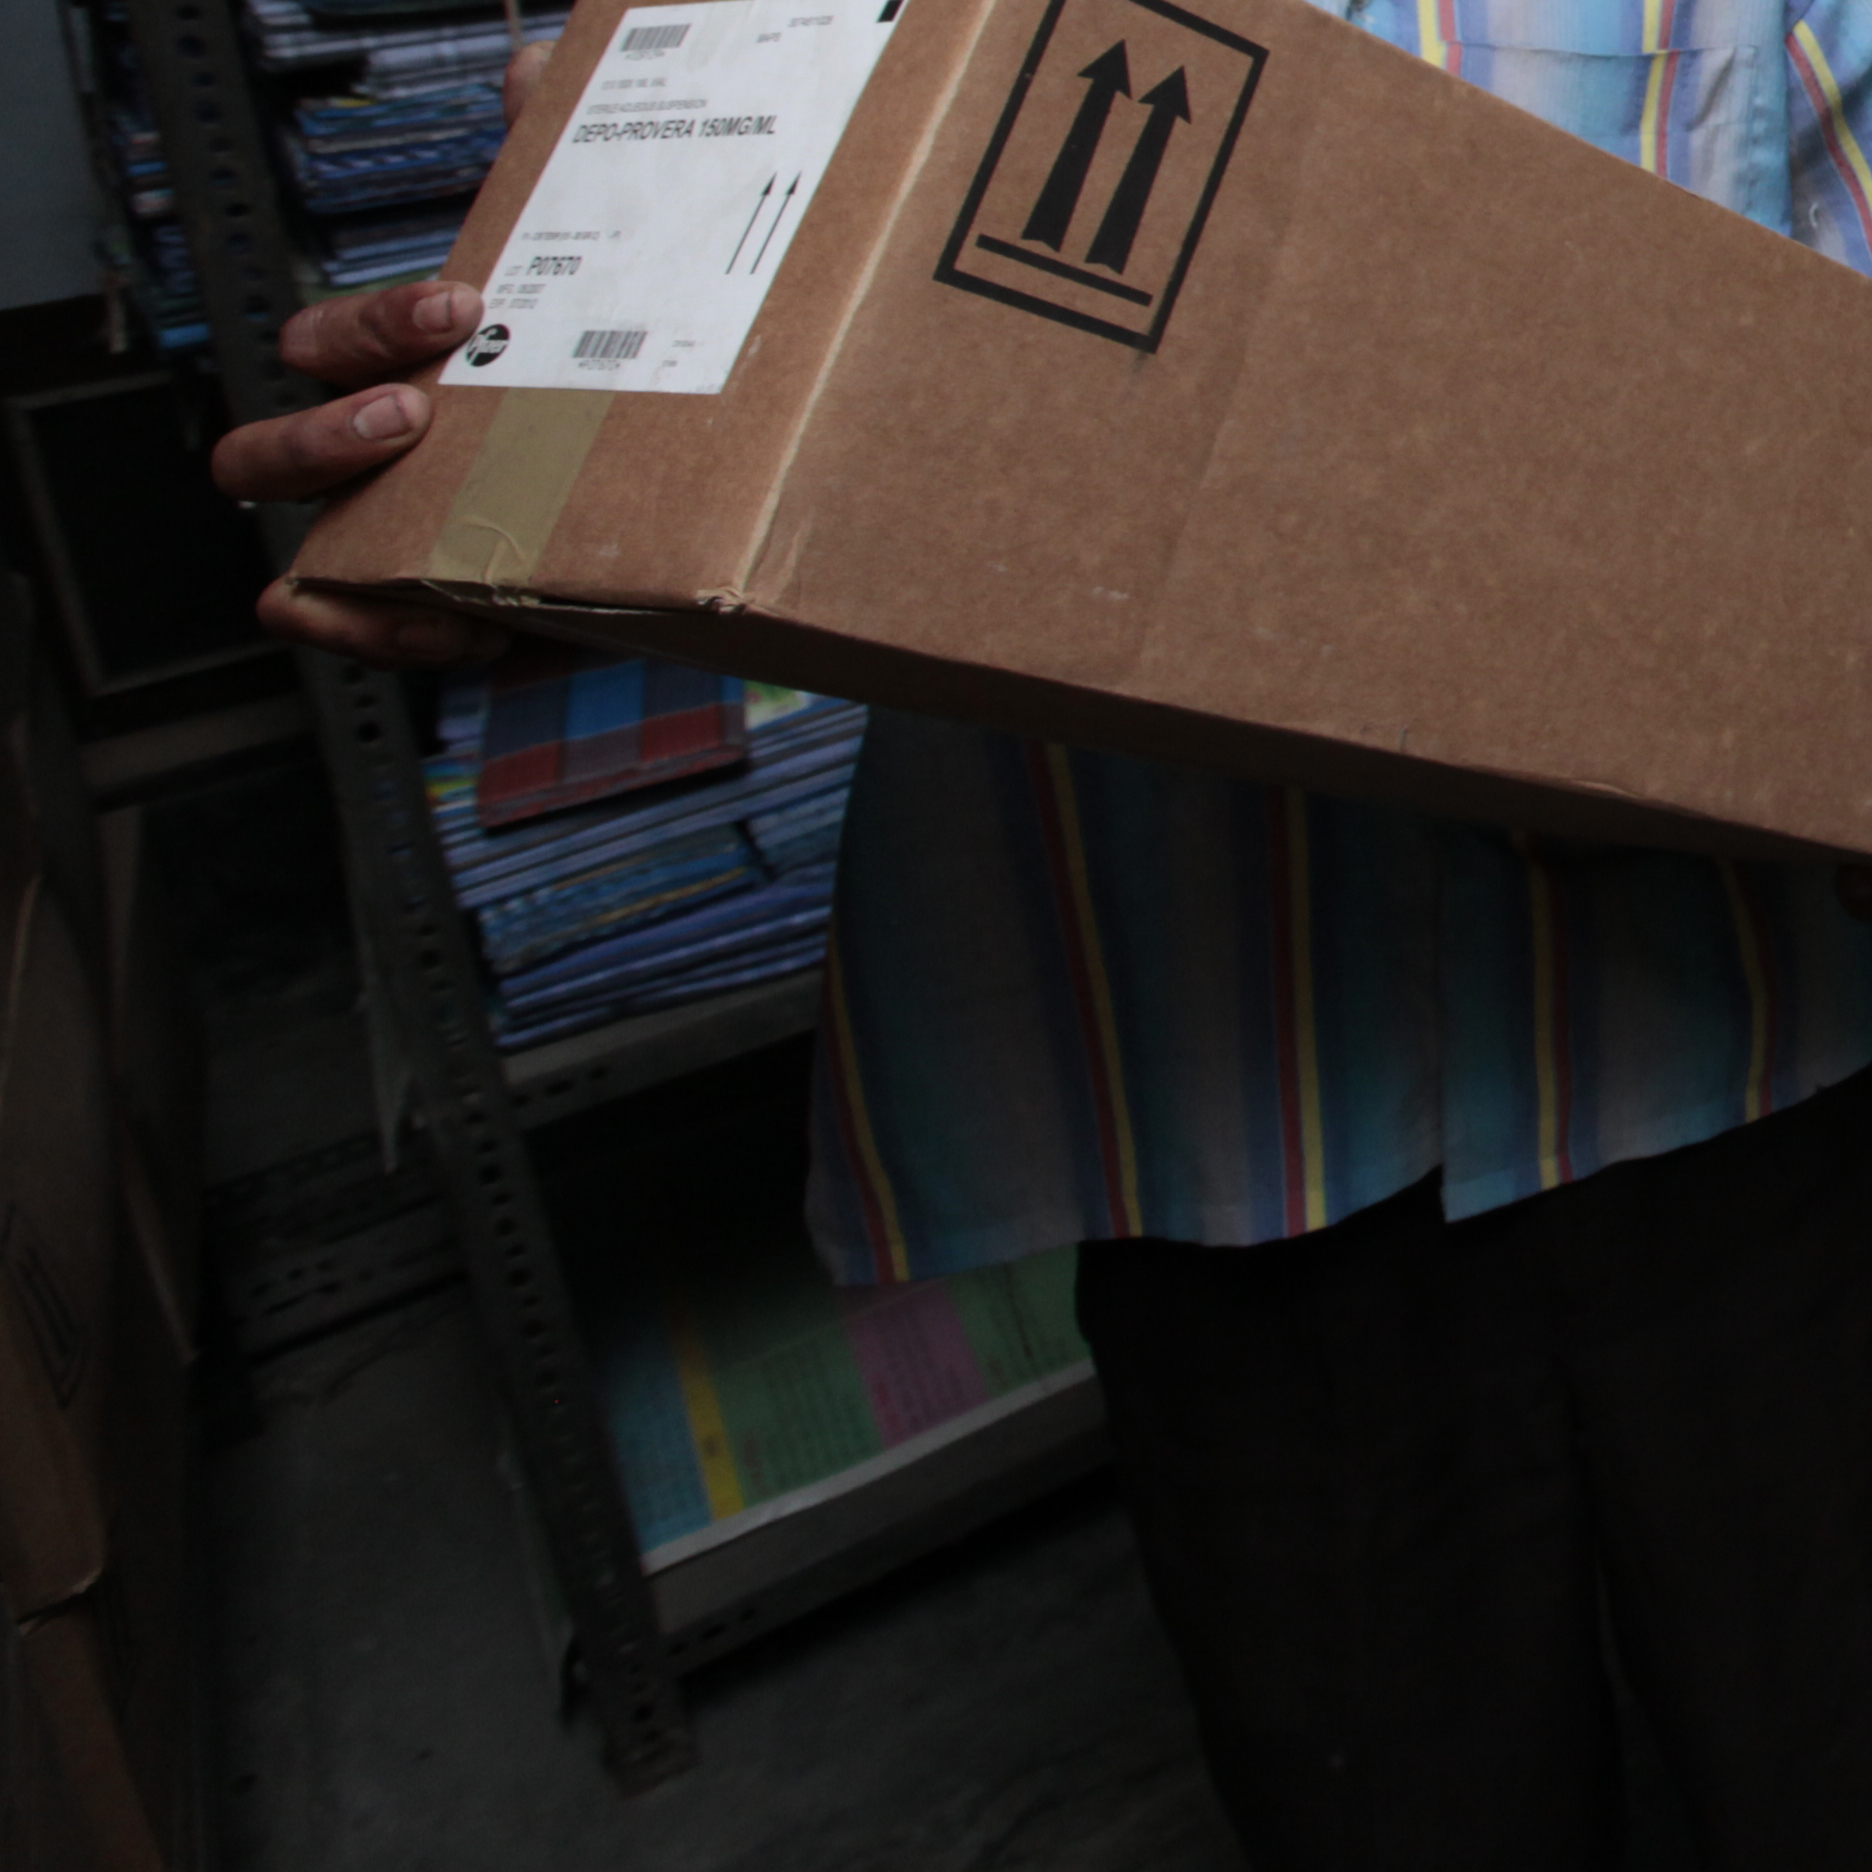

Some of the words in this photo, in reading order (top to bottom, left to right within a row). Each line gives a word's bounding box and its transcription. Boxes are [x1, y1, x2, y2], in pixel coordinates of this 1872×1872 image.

[571, 118, 698, 145] DEPO-PROVERA
[697, 114, 778, 138] 150MG/ML
[526, 255, 583, 276] P07670
